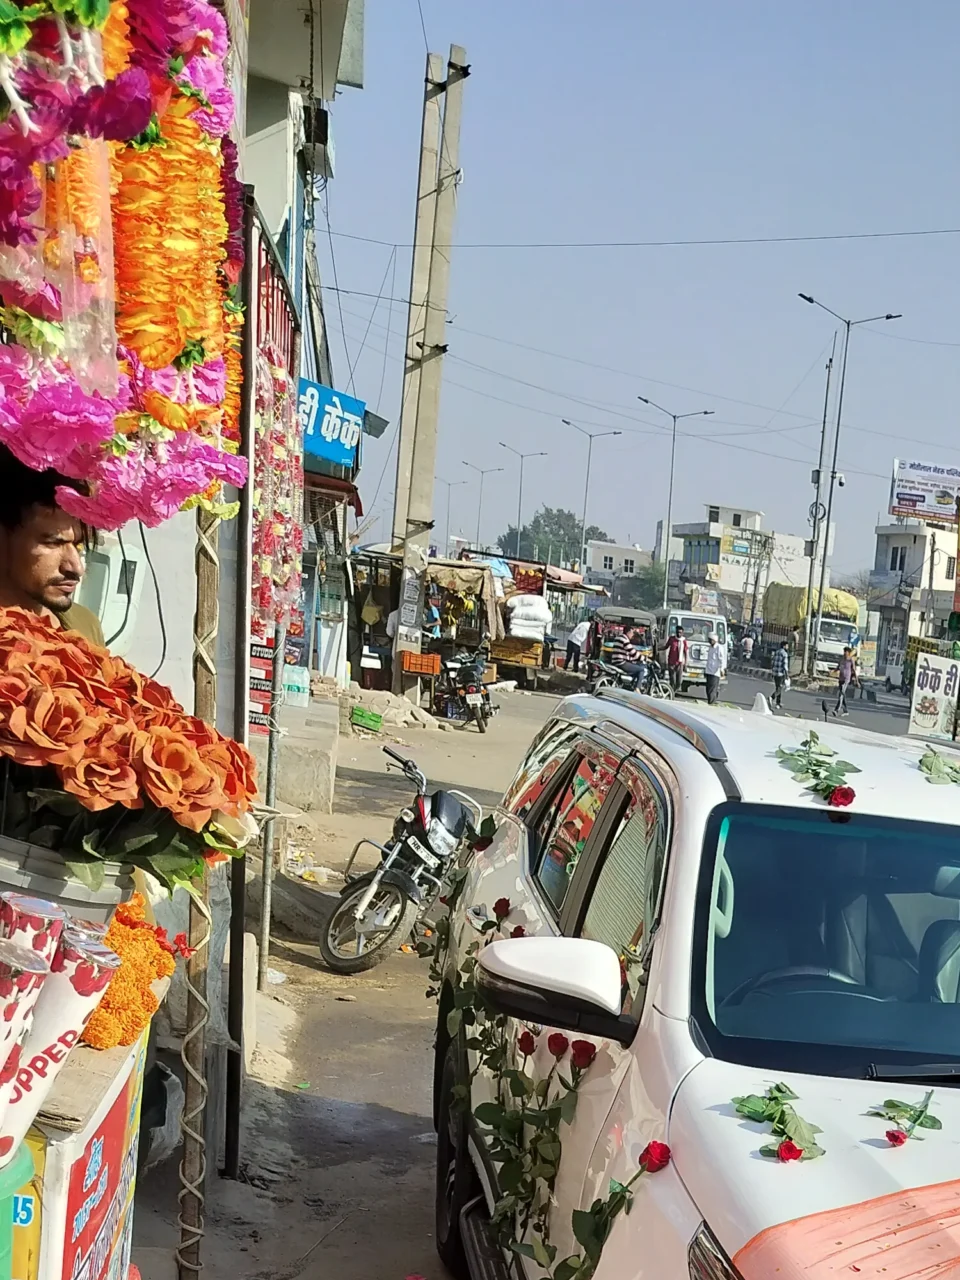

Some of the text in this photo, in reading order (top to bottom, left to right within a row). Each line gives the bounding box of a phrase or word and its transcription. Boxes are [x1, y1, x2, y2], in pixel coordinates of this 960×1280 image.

[321, 396, 362, 450] केक
[917, 657, 958, 697] केक ही
